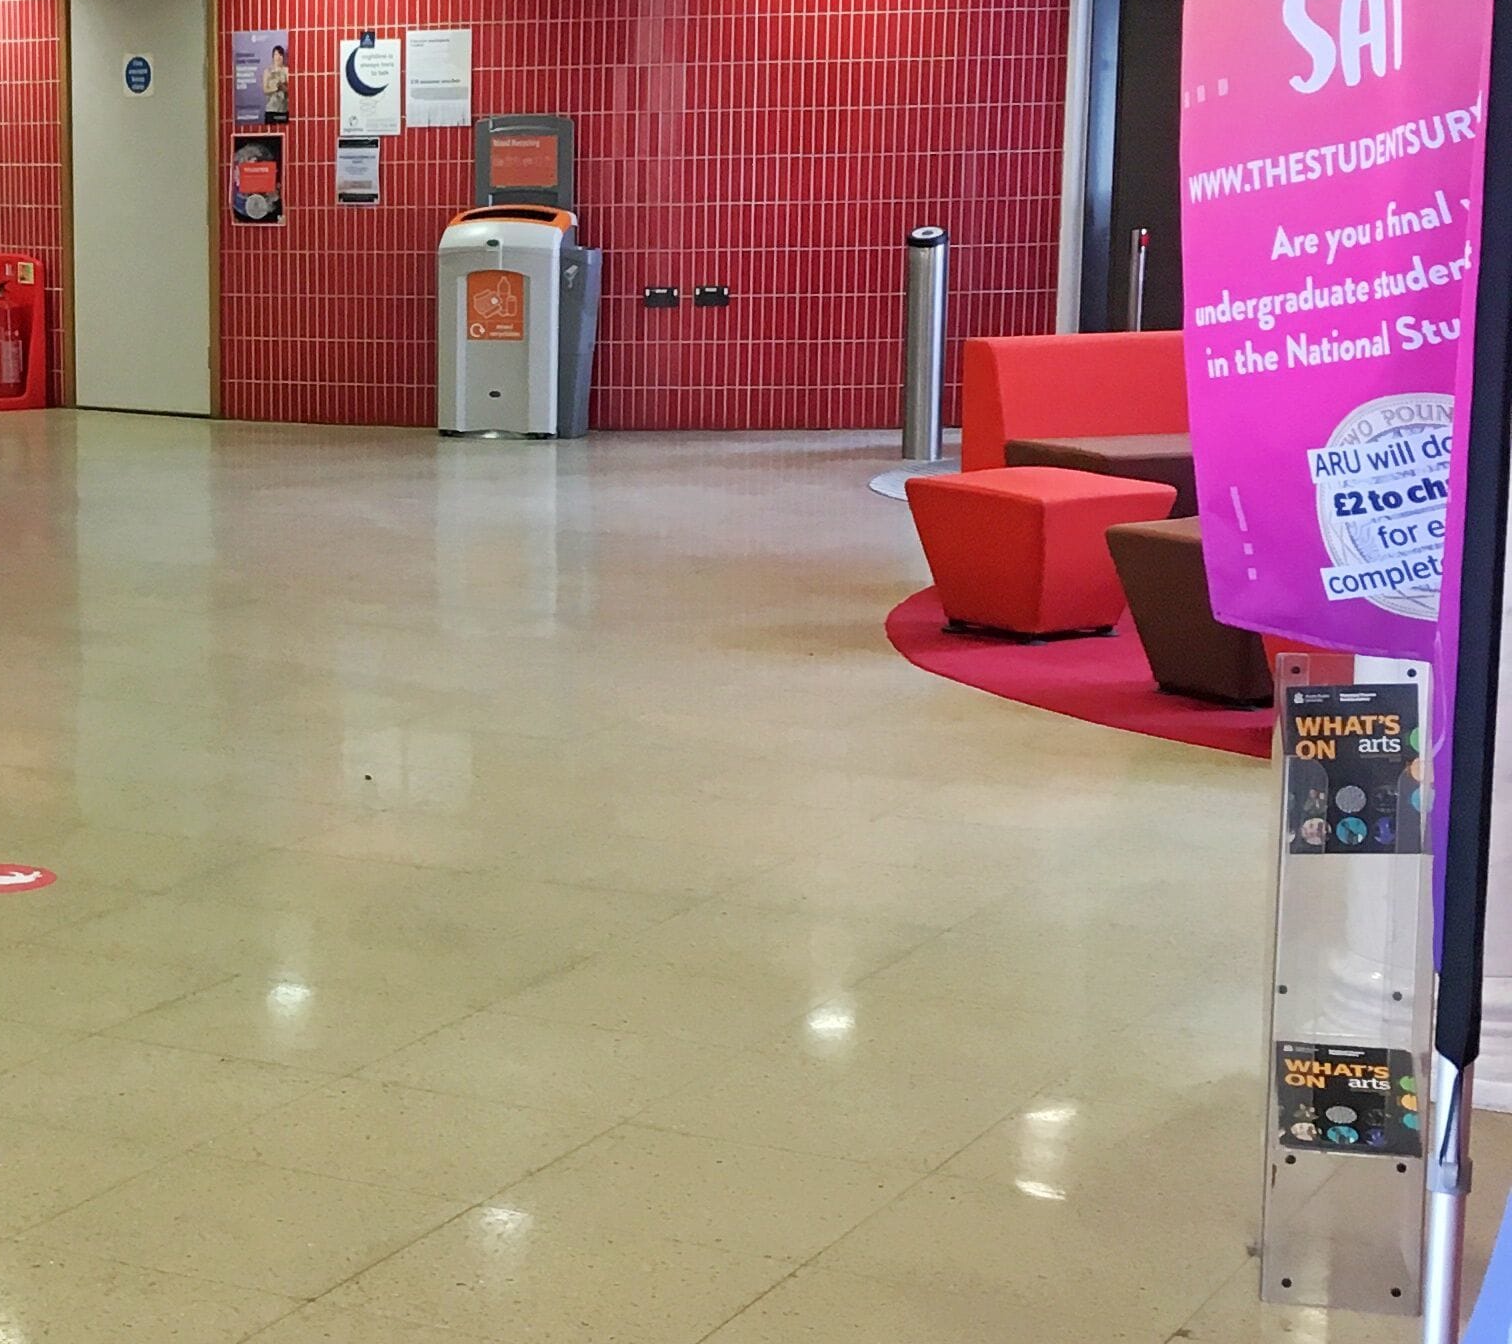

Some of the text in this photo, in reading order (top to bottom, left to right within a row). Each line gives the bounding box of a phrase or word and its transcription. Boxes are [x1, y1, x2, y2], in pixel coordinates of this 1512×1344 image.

[1271, 190, 1454, 265] Are you a final
[1194, 275, 1370, 332] undergraduate
[1206, 347, 1229, 379] in
[1235, 340, 1279, 375] the
[1286, 320, 1391, 369] National
[1315, 449, 1362, 478] ARU
[1366, 440, 1416, 471] will
[1333, 477, 1449, 517] £2 to ch
[1377, 524, 1419, 549] for
[1328, 554, 1444, 595] complet
[1295, 714, 1401, 736] WHAT'S
[1295, 736, 1401, 760] ON arts
[1284, 1058, 1390, 1079] WHAT'S
[1284, 1073, 1391, 1090] ON arts
